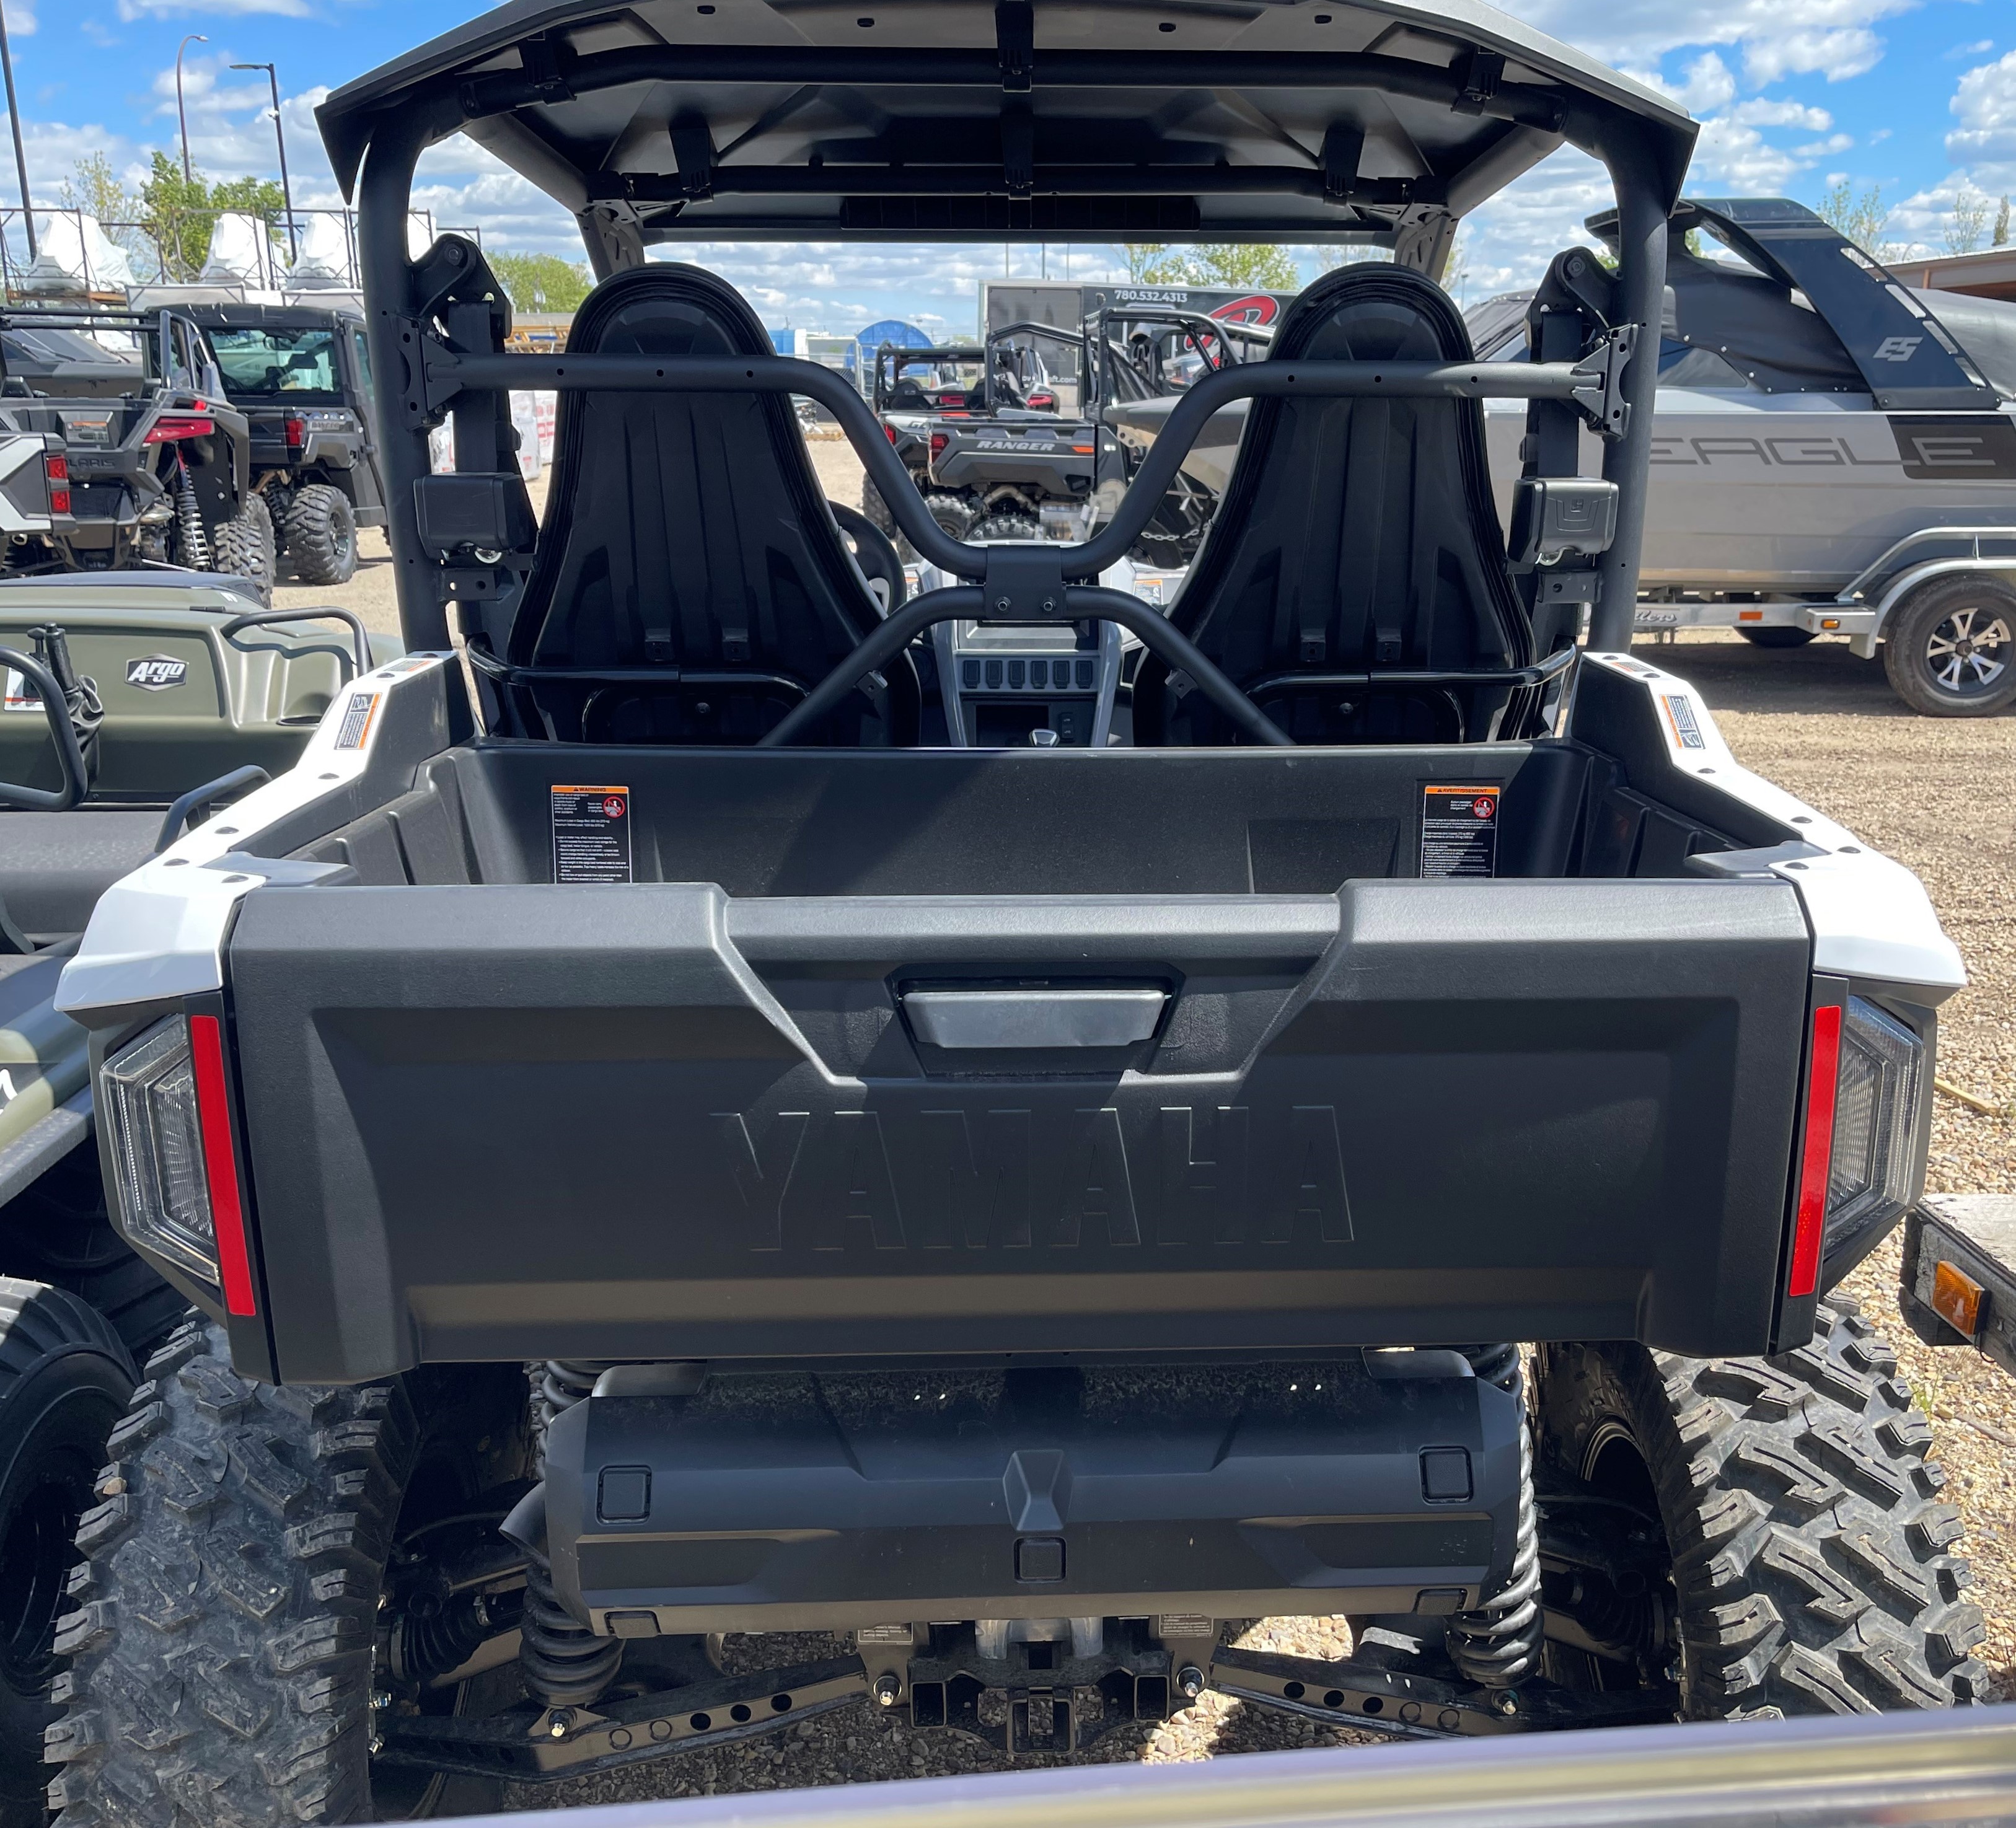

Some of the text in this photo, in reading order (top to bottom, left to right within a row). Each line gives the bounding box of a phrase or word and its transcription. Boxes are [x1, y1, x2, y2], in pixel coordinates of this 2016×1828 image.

[1114, 290, 1188, 302] 780.532.4313
[1873, 337, 1924, 361] ES
[977, 441, 1055, 451] RANGER
[1650, 437, 1997, 466] EAGLE
[66, 459, 116, 467] LARIS
[128, 662, 185, 682] Argo
[710, 1106, 1354, 1250] YAMAHA
